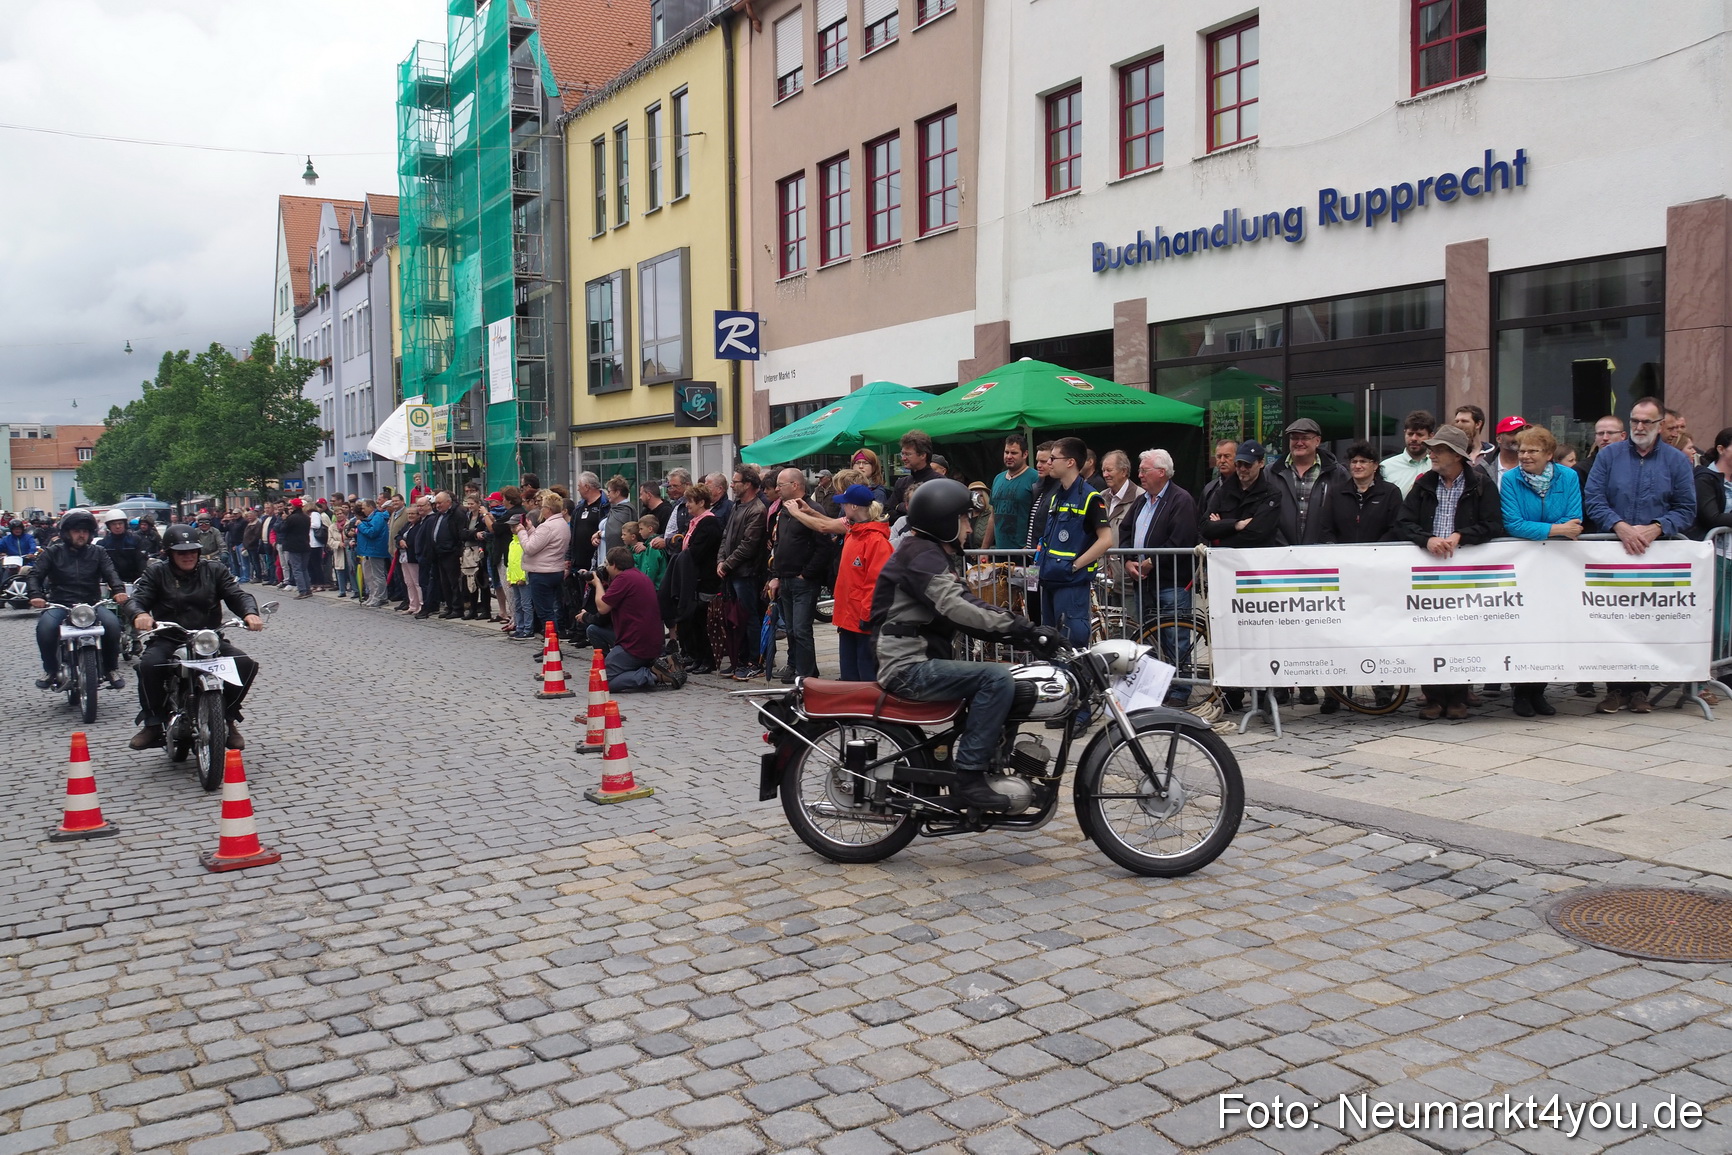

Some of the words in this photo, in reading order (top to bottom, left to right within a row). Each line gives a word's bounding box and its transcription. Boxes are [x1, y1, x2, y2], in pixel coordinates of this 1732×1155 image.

[1092, 204, 1306, 272] Buchhandlung
[1318, 148, 1529, 227] Rupprecht
[763, 374, 778, 383] Unterer
[778, 371, 790, 380] Markt
[790, 369, 796, 379] 15
[692, 393, 707, 412] G2
[1064, 397, 1146, 405] Lammsbräu
[1406, 591, 1524, 610] NeuerMarkt
[1581, 591, 1697, 607] NeuerMarkt
[1231, 596, 1346, 613] NeuerMarkt
[1237, 618, 1274, 626] einkaufen
[1278, 617, 1300, 625] leben
[1305, 616, 1342, 626] genießen
[1412, 614, 1451, 623] einkaufen
[1456, 613, 1479, 621] leben
[1483, 612, 1520, 622] genießen
[1589, 612, 1624, 620] einkaufen
[1628, 612, 1651, 620] leben
[1655, 612, 1691, 621] genießen
[1283, 659, 1328, 667] Dammstraße
[1449, 656, 1465, 664] über
[208, 664, 226, 672] 570
[1449, 665, 1487, 673] Parkplätze
[1578, 663, 1659, 671] www.neuermarkt-nm.de
